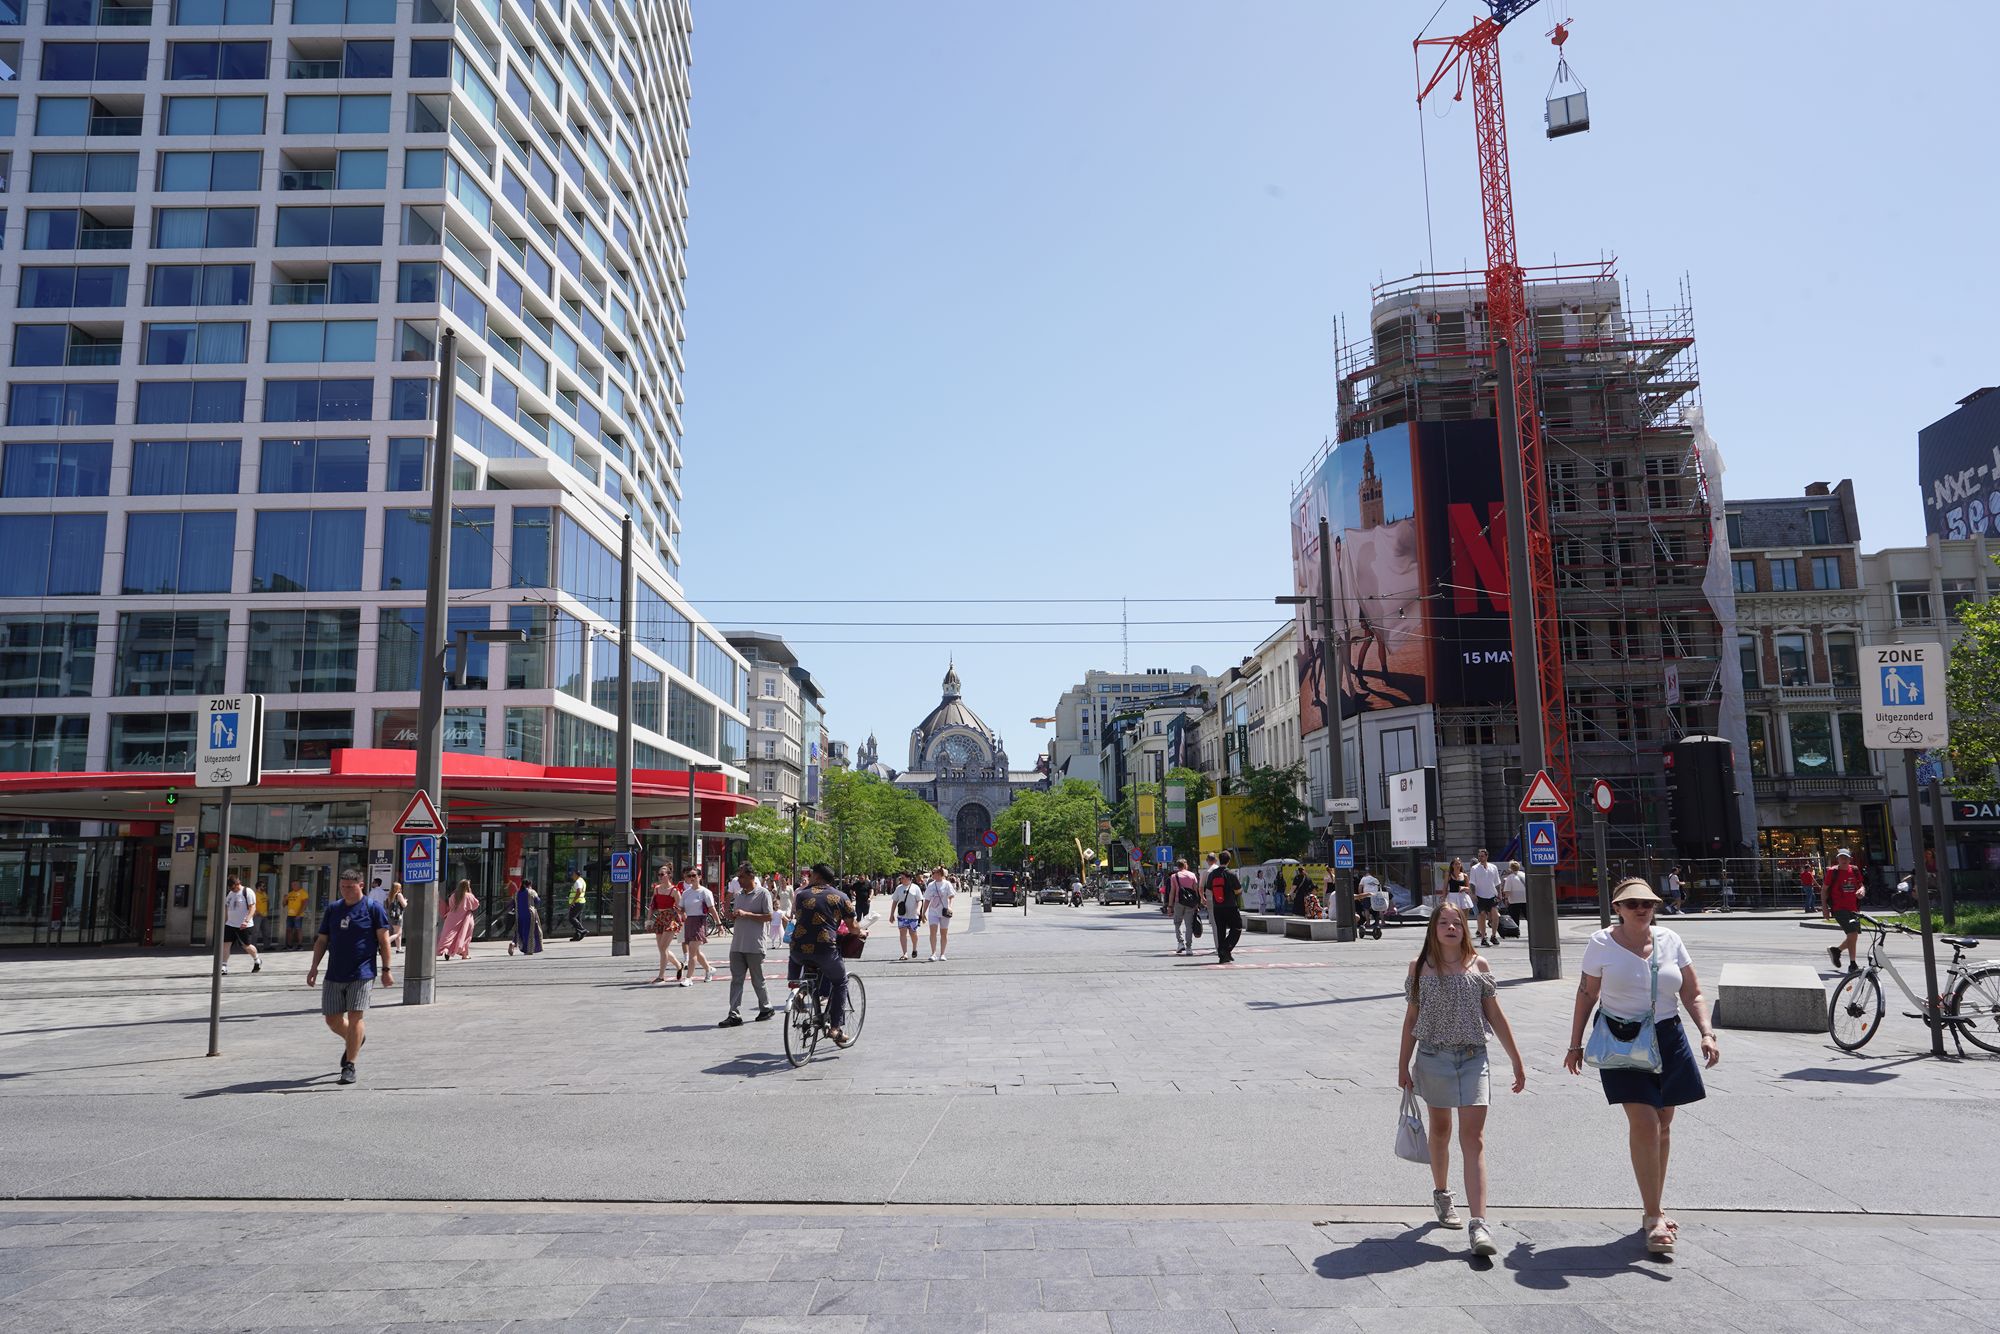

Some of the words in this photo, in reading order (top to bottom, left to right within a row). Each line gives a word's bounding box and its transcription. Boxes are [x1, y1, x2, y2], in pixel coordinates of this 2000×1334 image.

[1448, 502, 1510, 615] N
[1463, 652, 1481, 664] 15
[1878, 649, 1924, 663] ZONE
[210, 699, 241, 711] ZONE
[1875, 712, 1934, 723] Uitgezonderd
[129, 751, 175, 766] Meda
[204, 755, 241, 764] Uitgezonderd
[180, 834, 190, 847] P
[408, 870, 430, 879] TRAM
